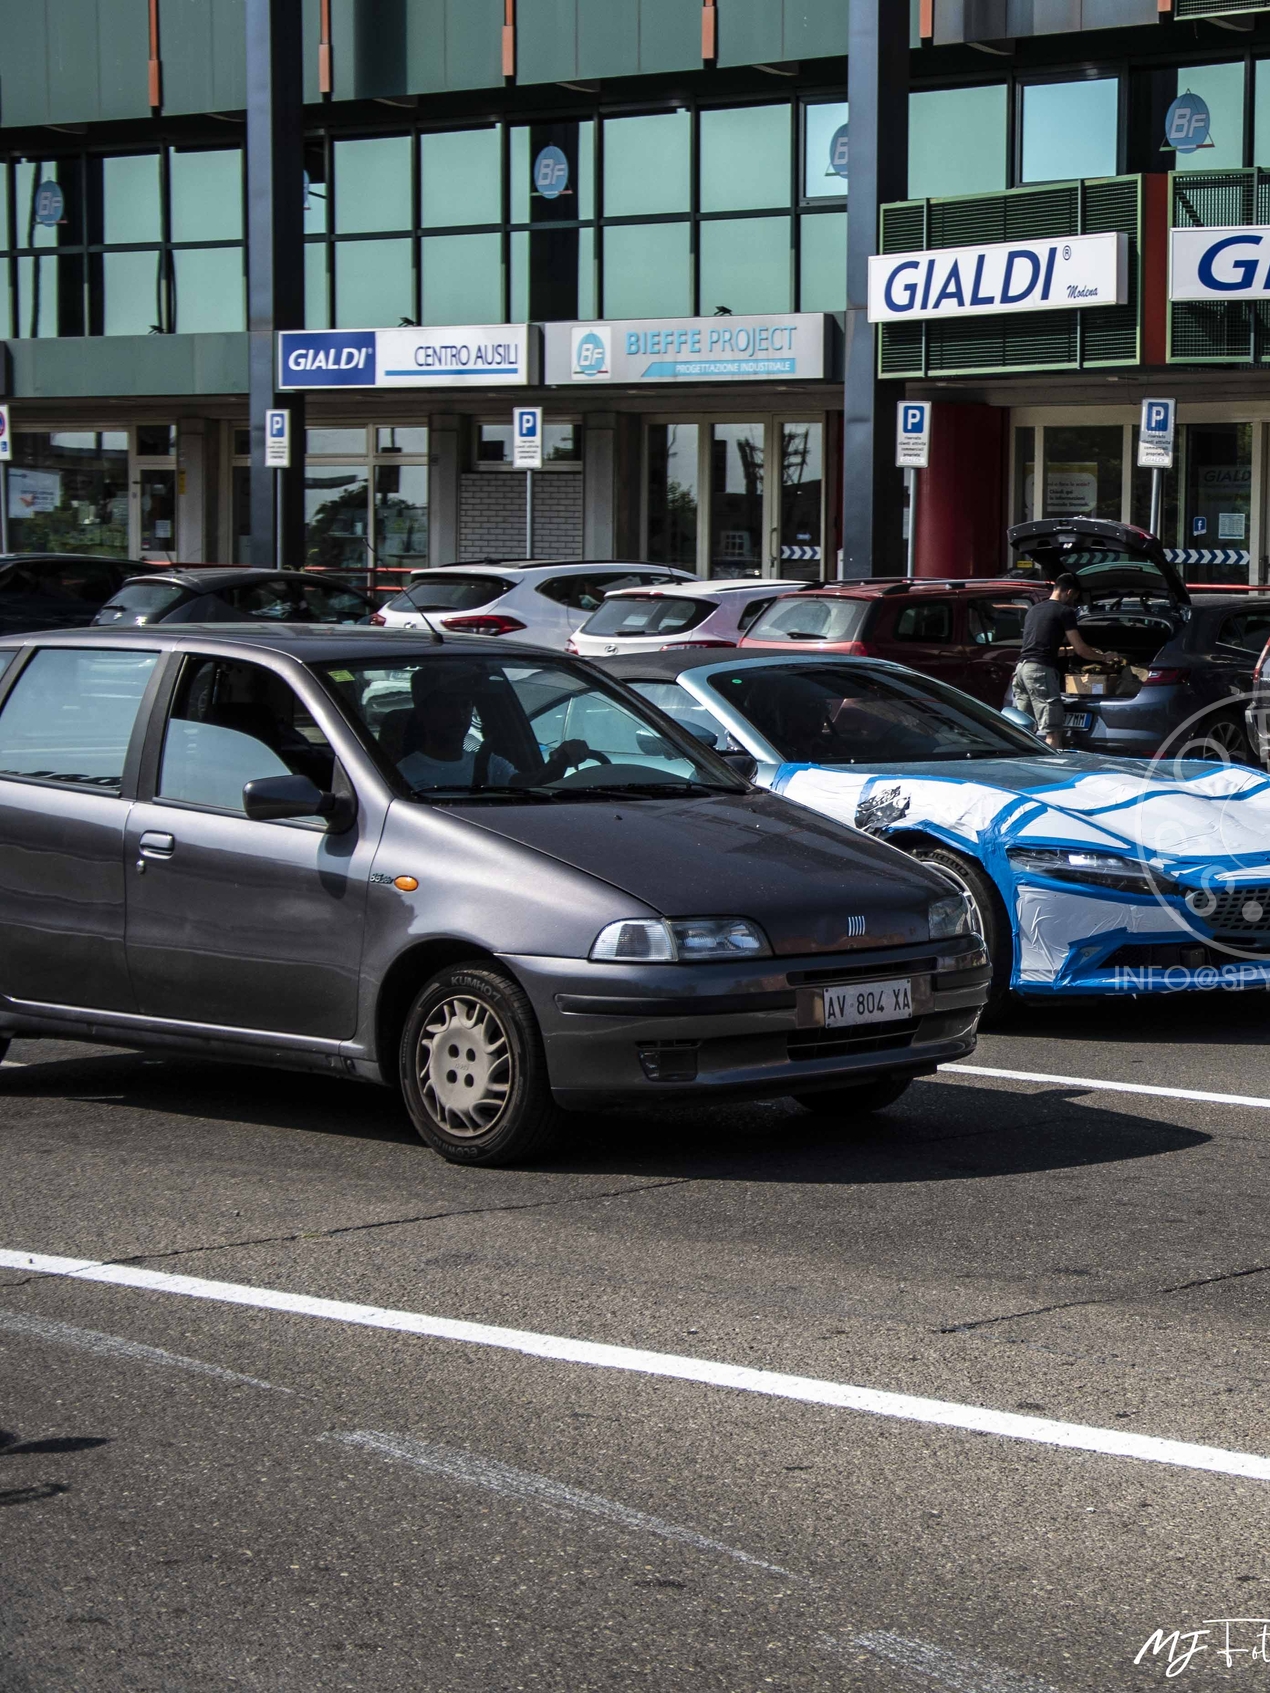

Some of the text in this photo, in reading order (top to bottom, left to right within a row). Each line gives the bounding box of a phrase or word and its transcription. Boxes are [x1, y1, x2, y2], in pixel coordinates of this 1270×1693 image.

[1168, 106, 1208, 139] BF
[832, 136, 849, 165] B
[537, 158, 566, 187] BF
[884, 247, 1058, 313] GIALDI
[1066, 283, 1099, 300] Modena
[625, 325, 798, 358] BIEFFE PROJECT
[288, 347, 367, 371] GIALDI
[414, 343, 518, 367] CENTRO AUSILI
[578, 343, 606, 368] BF
[675, 360, 791, 374] PROGETTAZIONE INDUSTRIALE
[272, 416, 282, 437] P
[522, 414, 534, 434] P
[906, 409, 922, 430] P
[1150, 406, 1165, 428] P
[450, 976, 492, 996] KUMHO
[827, 988, 911, 1020] AV 804 XA
